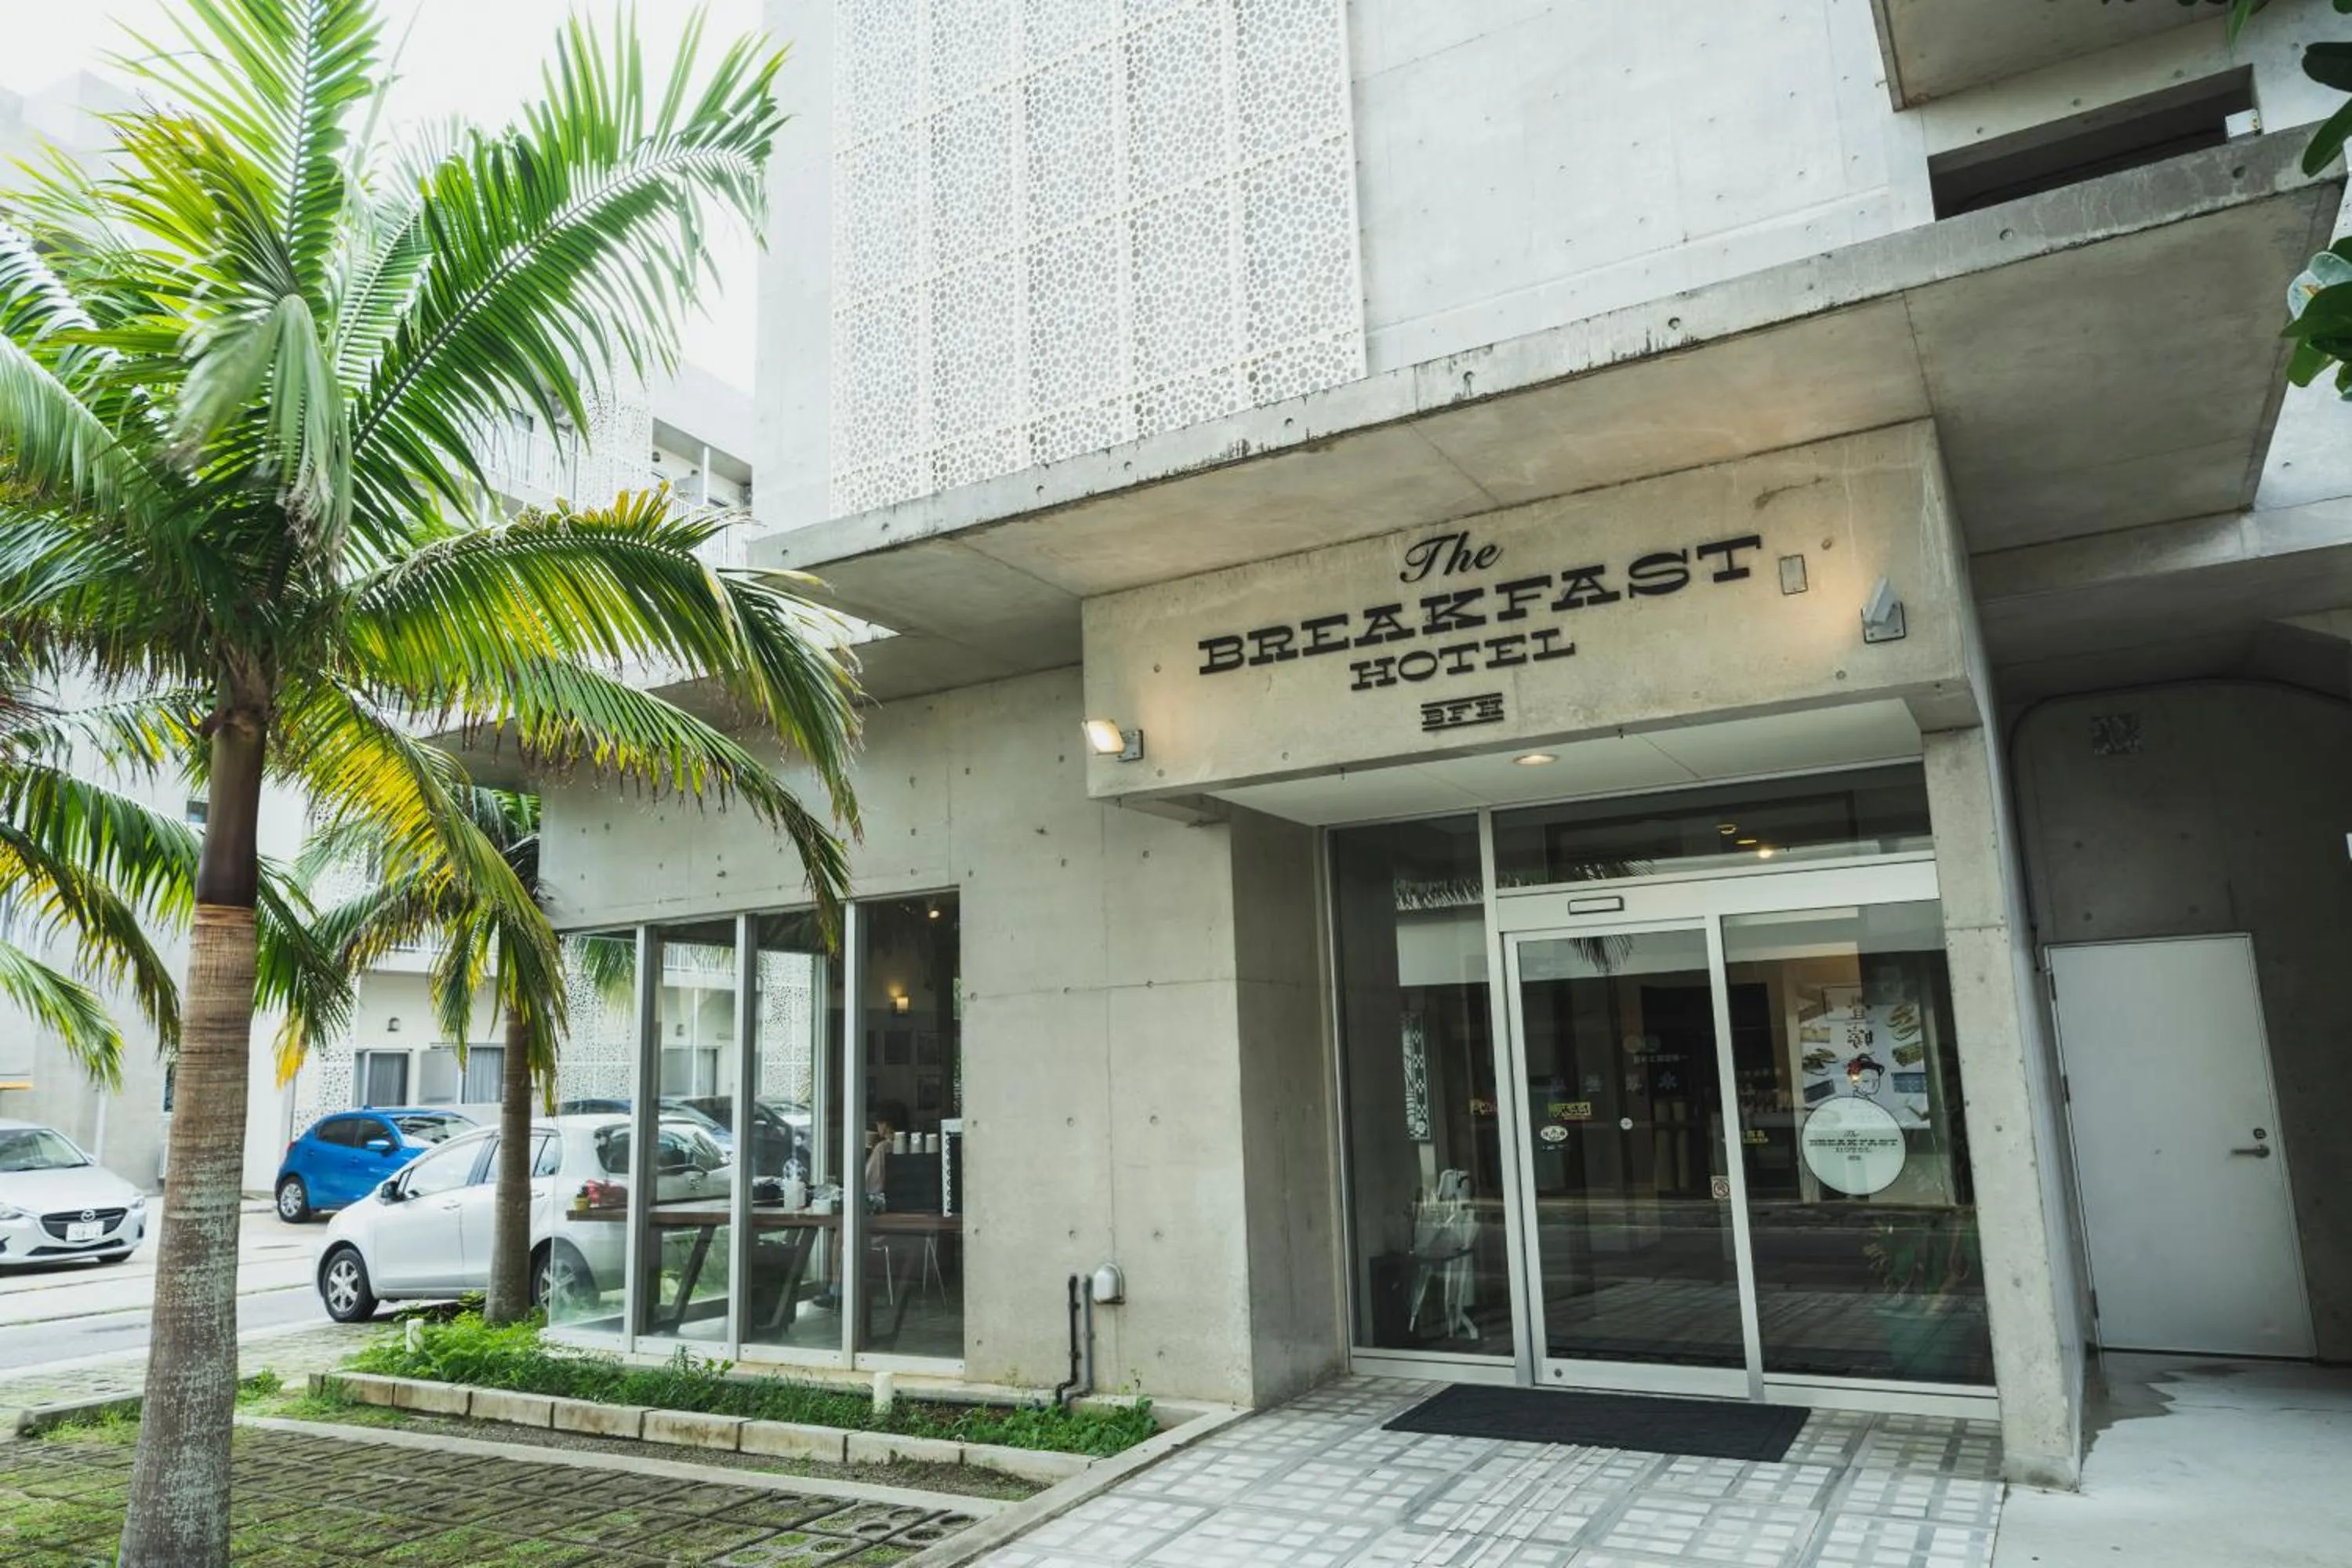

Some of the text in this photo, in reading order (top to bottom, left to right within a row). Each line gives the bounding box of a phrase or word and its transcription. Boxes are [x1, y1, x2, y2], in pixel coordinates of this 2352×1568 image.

[1399, 530, 1504, 583] The
[1198, 534, 1762, 675] BREAKFAST
[1349, 628, 1577, 691] HOTEL
[1421, 699, 1504, 726] BFH
